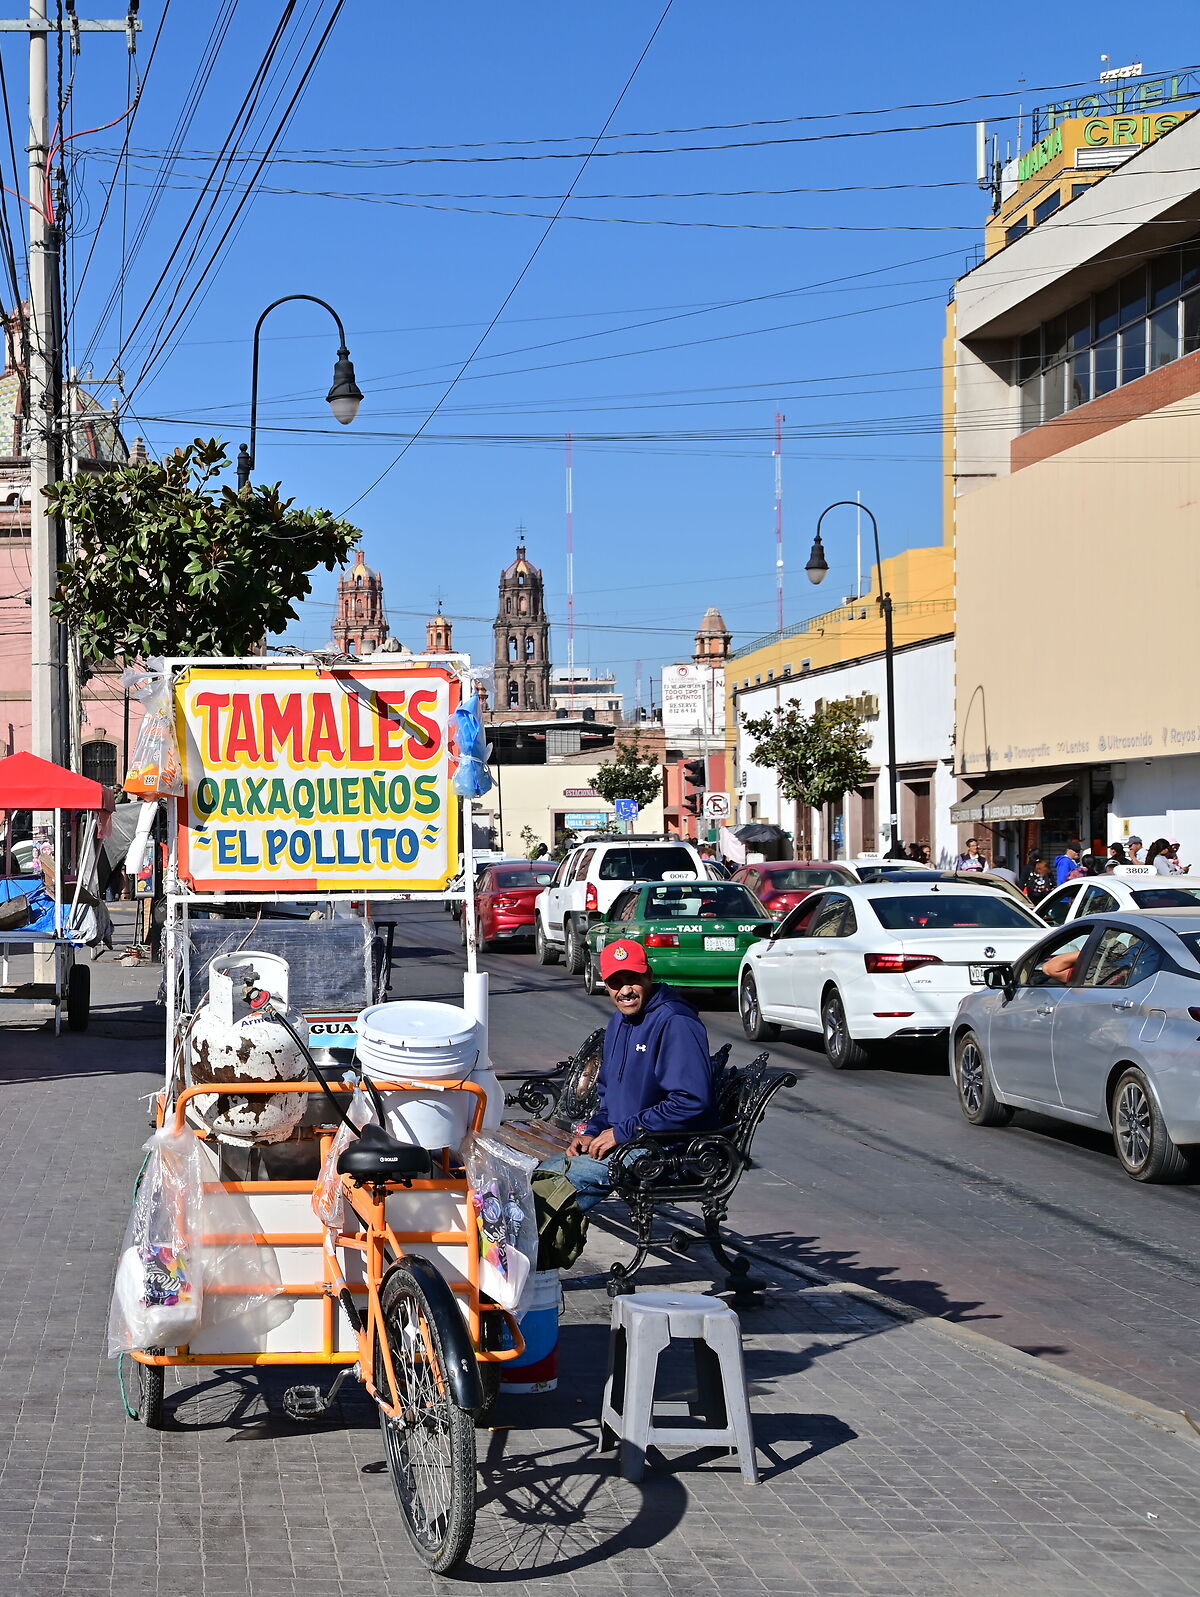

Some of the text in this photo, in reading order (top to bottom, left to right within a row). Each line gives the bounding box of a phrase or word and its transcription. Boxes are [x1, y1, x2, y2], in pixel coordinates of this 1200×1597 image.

[1047, 76, 1199, 129] HOTEL
[1084, 115, 1180, 146] CRIS
[196, 690, 441, 765] TAMALES
[197, 770, 440, 819] OAXAQUEÑOS
[215, 828, 420, 866] EL POLLITO
[309, 1023, 358, 1035] GUA
